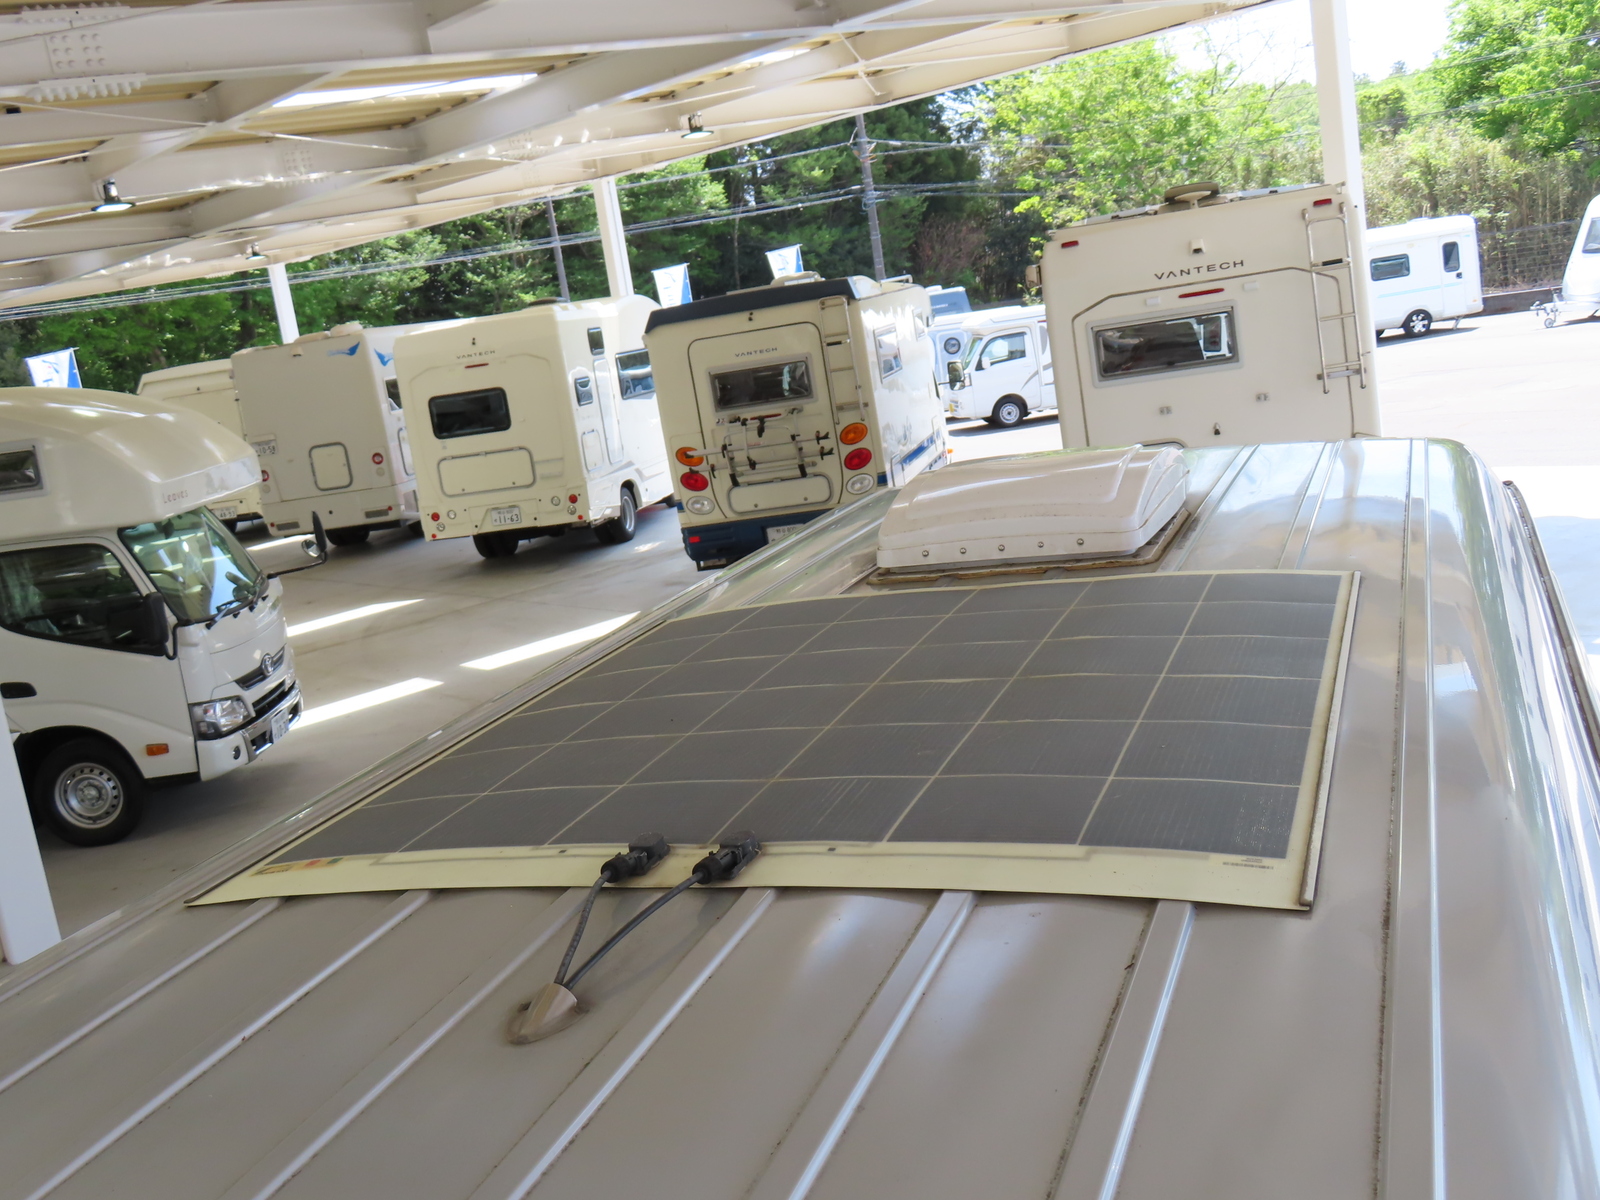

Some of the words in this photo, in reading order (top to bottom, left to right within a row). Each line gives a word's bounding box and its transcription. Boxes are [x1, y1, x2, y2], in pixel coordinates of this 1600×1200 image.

[1154, 260, 1245, 280] VANTECH
[456, 349, 496, 360] VANTECH
[734, 347, 779, 358] VANTECH
[498, 512, 520, 524] 11-63
